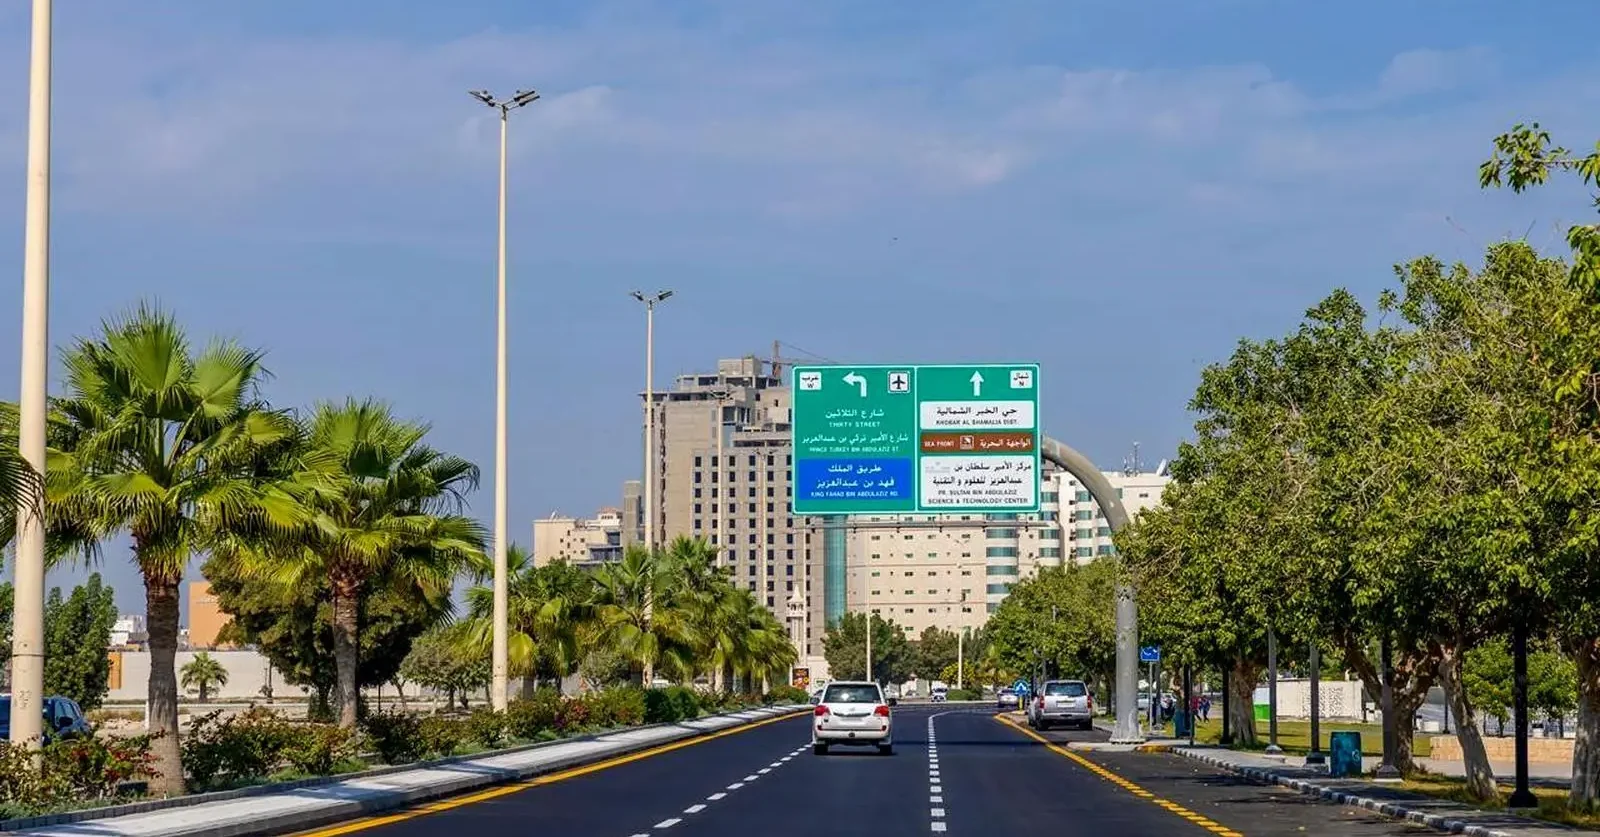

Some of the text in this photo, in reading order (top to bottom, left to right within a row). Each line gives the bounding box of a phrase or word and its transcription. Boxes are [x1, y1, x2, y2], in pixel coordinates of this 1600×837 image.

[826, 408, 884, 418] شارع الثلاثين
[976, 407, 998, 416] الخبر
[1002, 408, 1017, 417] حي
[802, 431, 908, 445] شارع الأمير تركي بن عبدالعزيز
[980, 437, 1030, 448] الواجهة البحرية
[828, 464, 881, 474] طريق الملك
[966, 462, 990, 471] سلطان
[994, 460, 1012, 472] الأمير
[1016, 462, 1031, 471] مركز
[817, 477, 894, 488] فهد بن عبدالعزيز
[933, 476, 955, 485] التقنية
[964, 476, 986, 486] للعلوم
[990, 476, 1022, 486] عبدالعزيز
